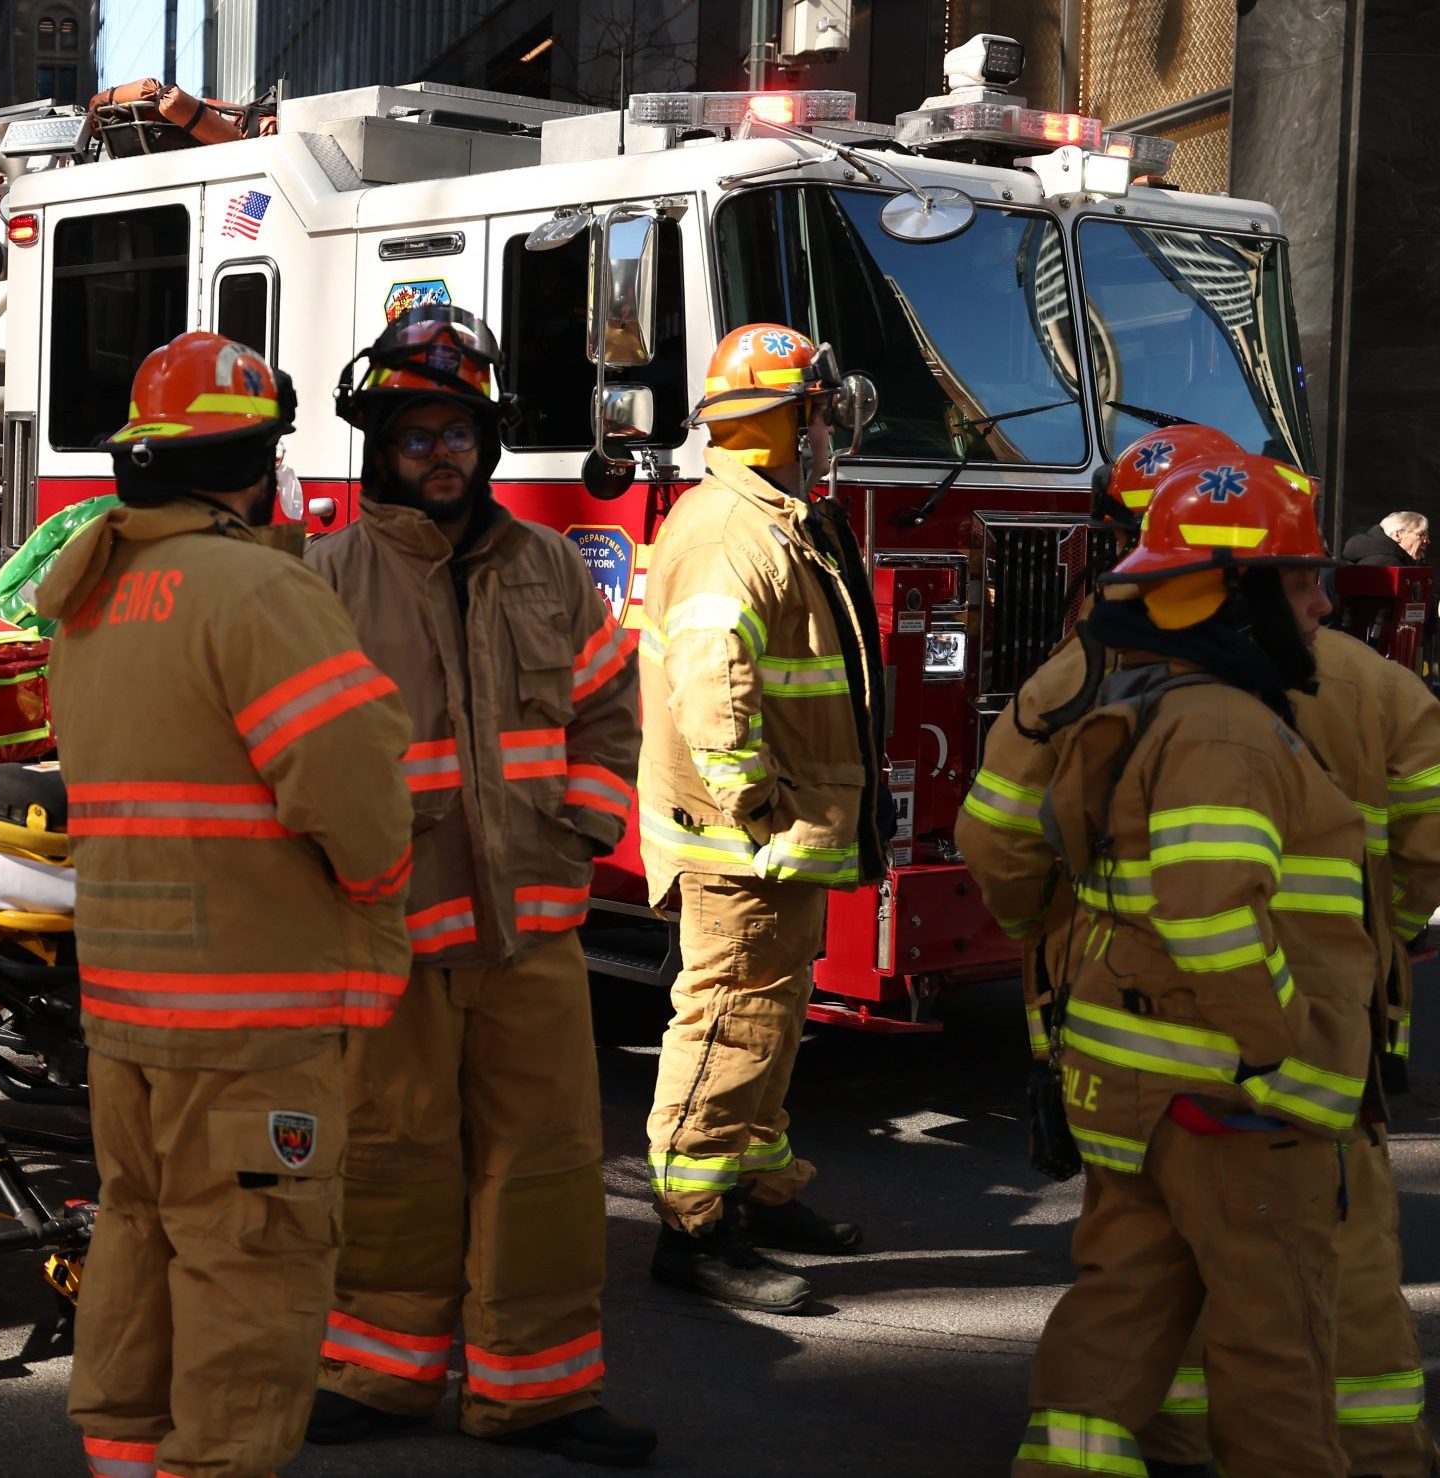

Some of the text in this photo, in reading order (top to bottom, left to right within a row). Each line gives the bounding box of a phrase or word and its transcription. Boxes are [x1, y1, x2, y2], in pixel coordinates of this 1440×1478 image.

[579, 533, 626, 563] DEPARTMENT
[579, 547, 610, 557] CITY OF
[593, 559, 615, 569] YORK
[108, 568, 184, 625] EMS
